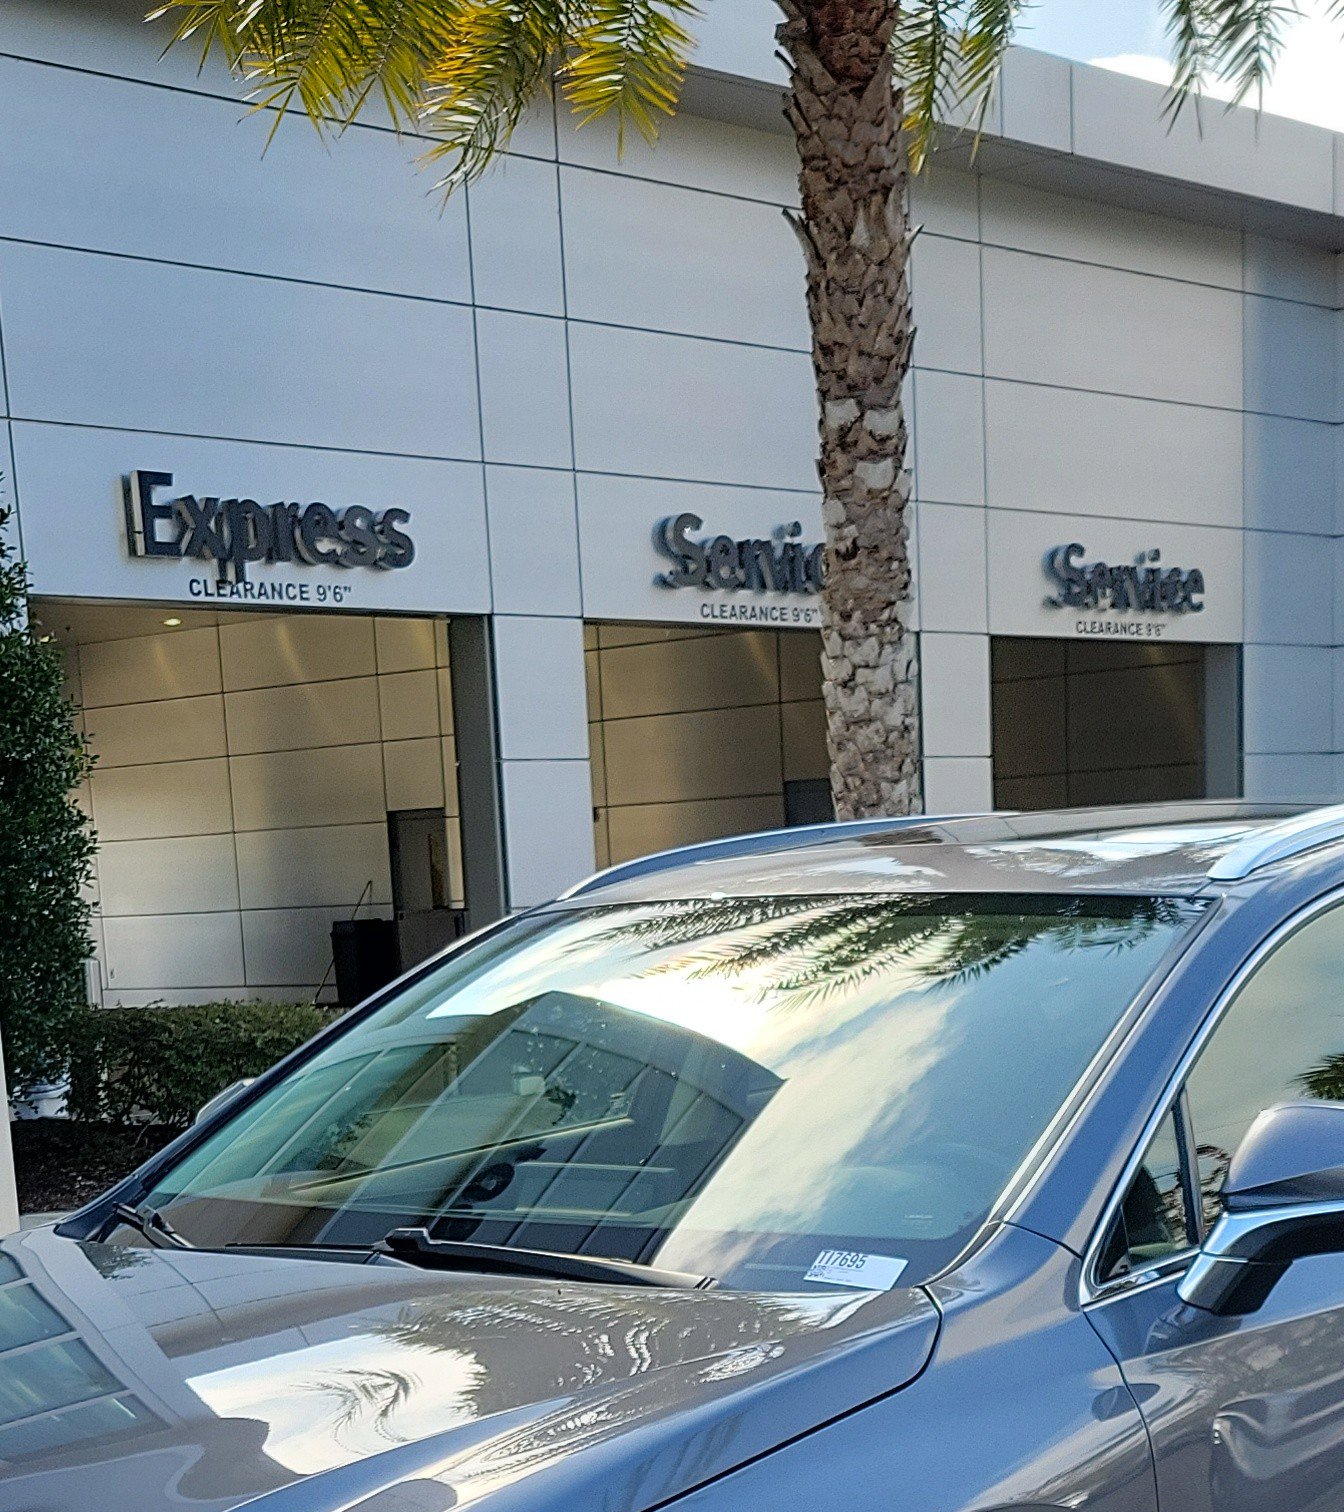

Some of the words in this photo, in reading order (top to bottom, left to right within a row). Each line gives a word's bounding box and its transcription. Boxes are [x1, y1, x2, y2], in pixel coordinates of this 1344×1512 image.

[130, 469, 416, 584] Express
[656, 512, 827, 593] Servic
[189, 578, 310, 601] CLEARANCE
[1046, 542, 1205, 613] Service
[700, 603, 788, 622] CLEARANCE
[1075, 620, 1143, 636] CLEARANCE
